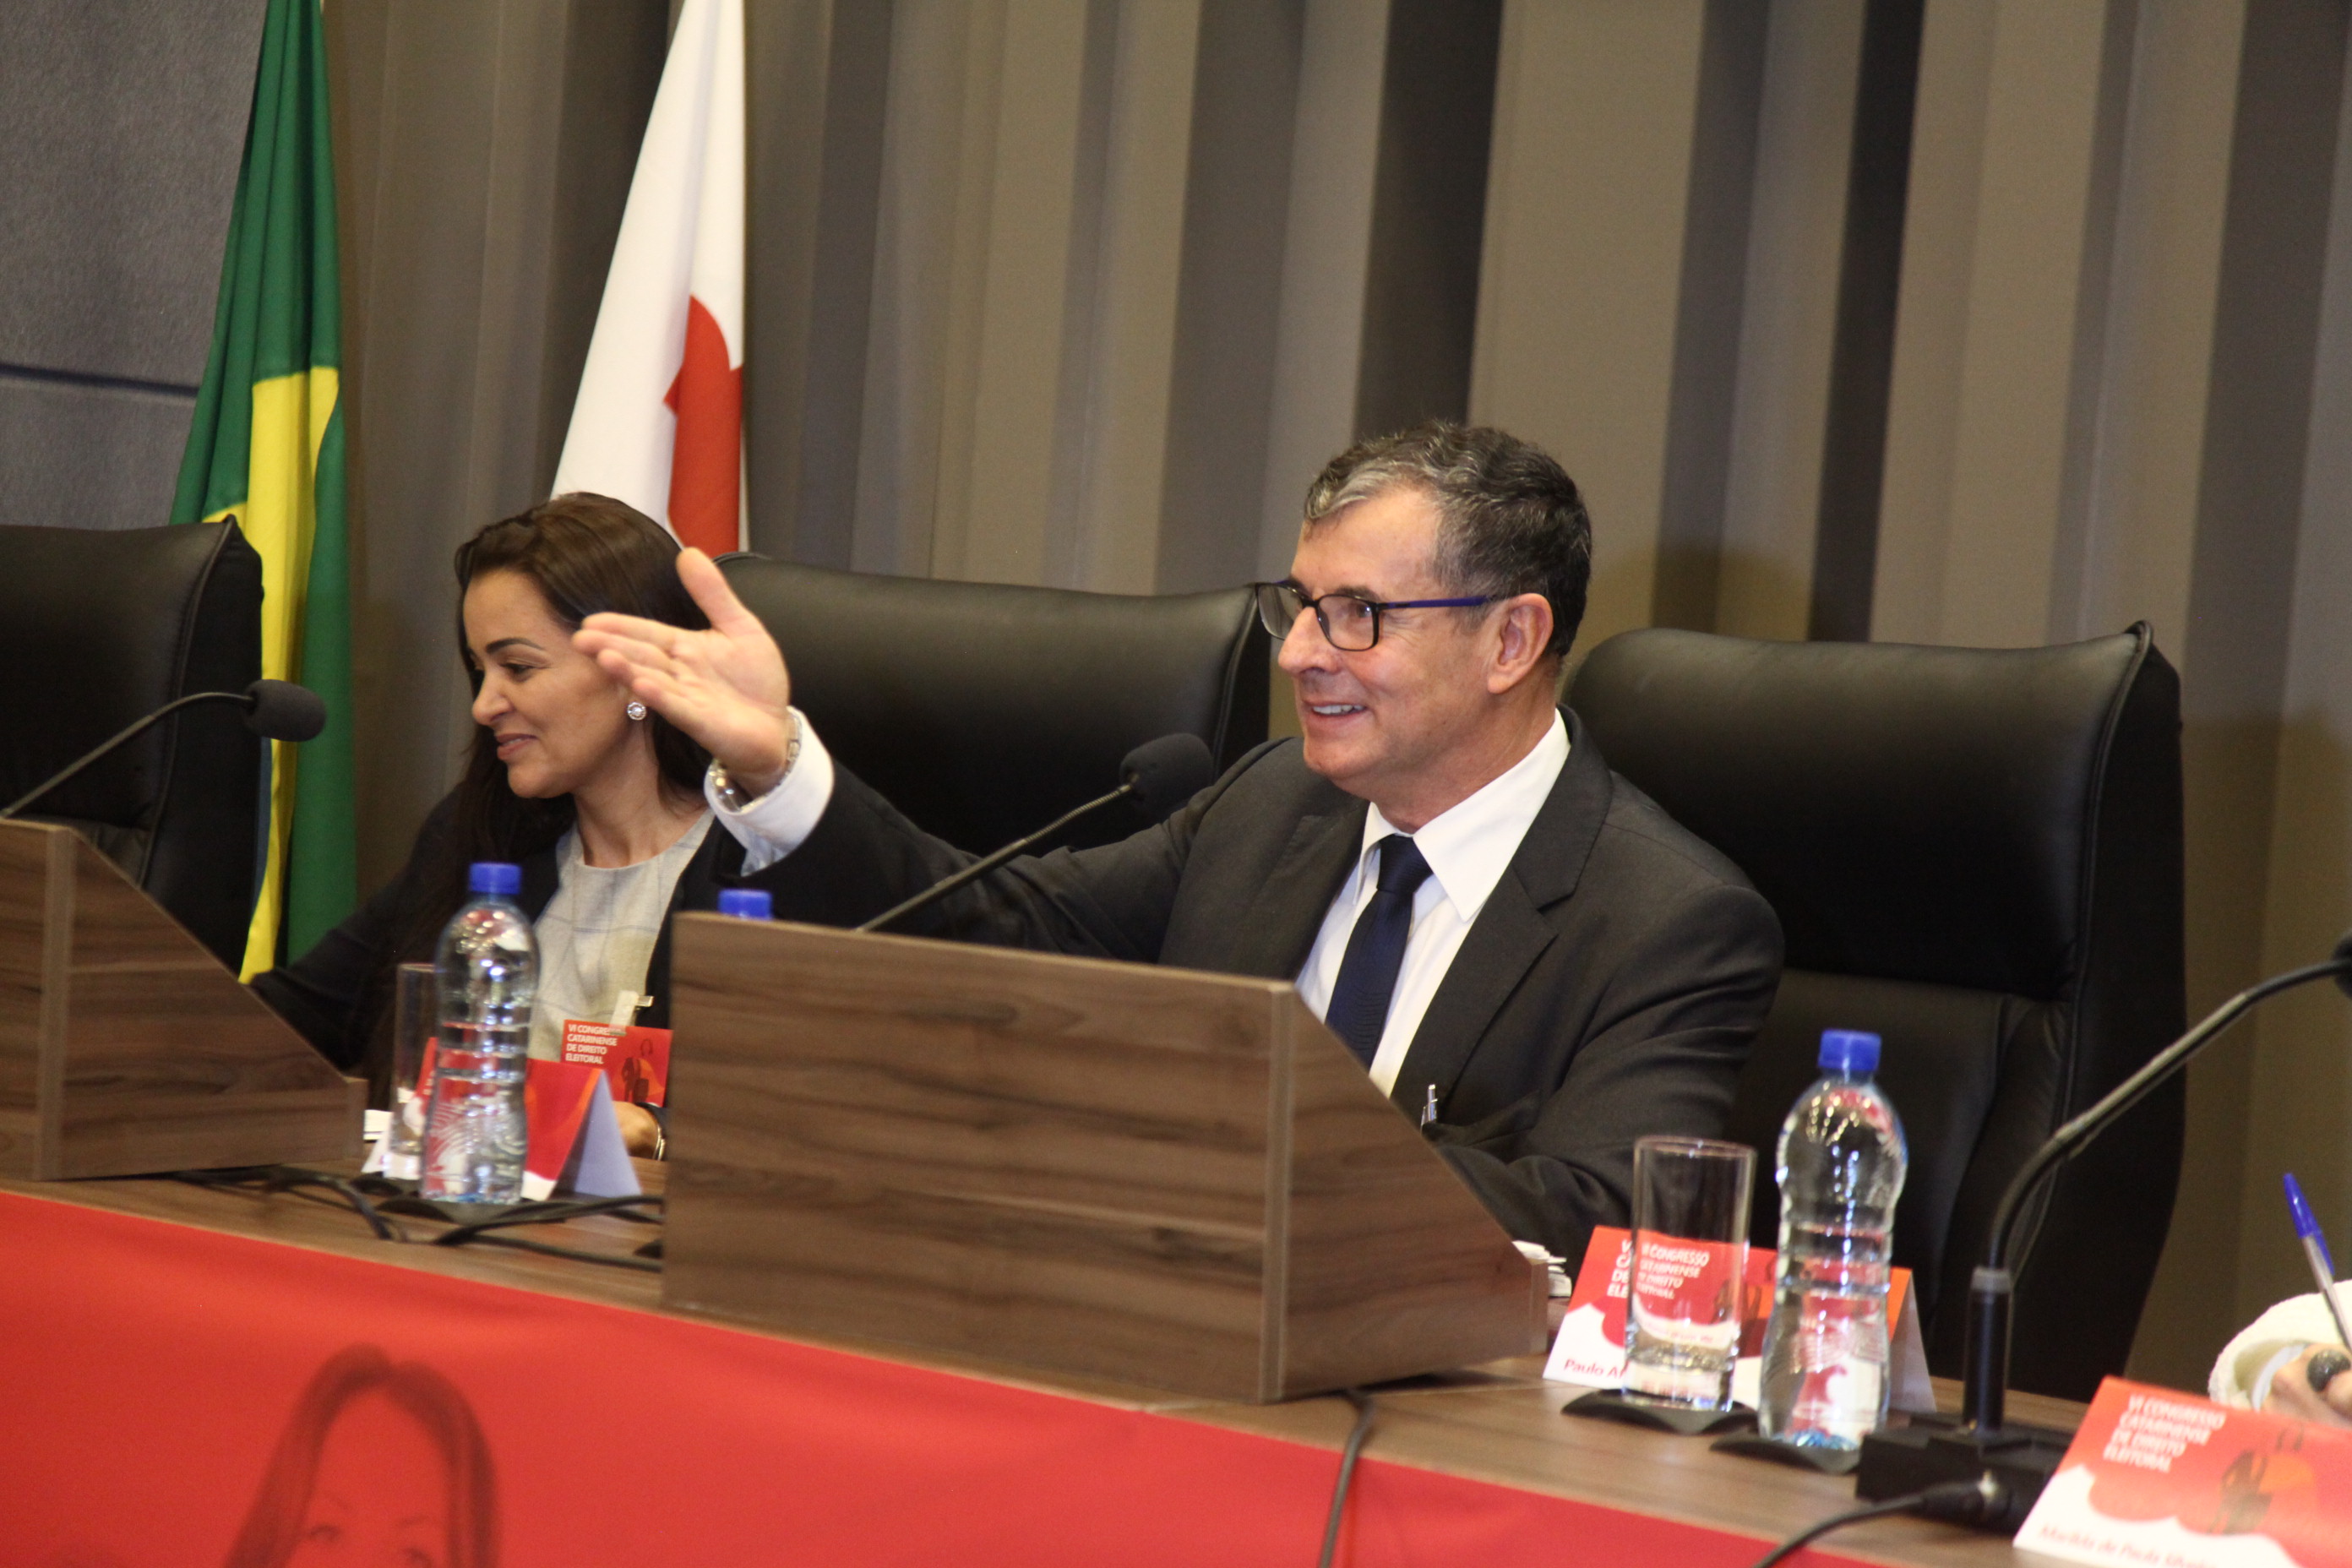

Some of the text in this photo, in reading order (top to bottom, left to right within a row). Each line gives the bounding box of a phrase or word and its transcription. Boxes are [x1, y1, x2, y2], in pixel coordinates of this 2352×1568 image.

[569, 1024, 576, 1032] VI
[566, 1043, 607, 1054] DE DIREITO
[567, 1033, 618, 1046] CATARINENSE
[565, 1053, 604, 1064] ELEITORAL
[1649, 1243, 1710, 1267] CONGRESSO
[1565, 1358, 1603, 1376] Paulo
[2143, 1396, 2226, 1431] CONGRESSO
[2119, 1412, 2211, 1446] CATARINENSE
[2132, 1432, 2187, 1458] DIREITO
[2103, 1442, 2172, 1473] ELEITORAL
